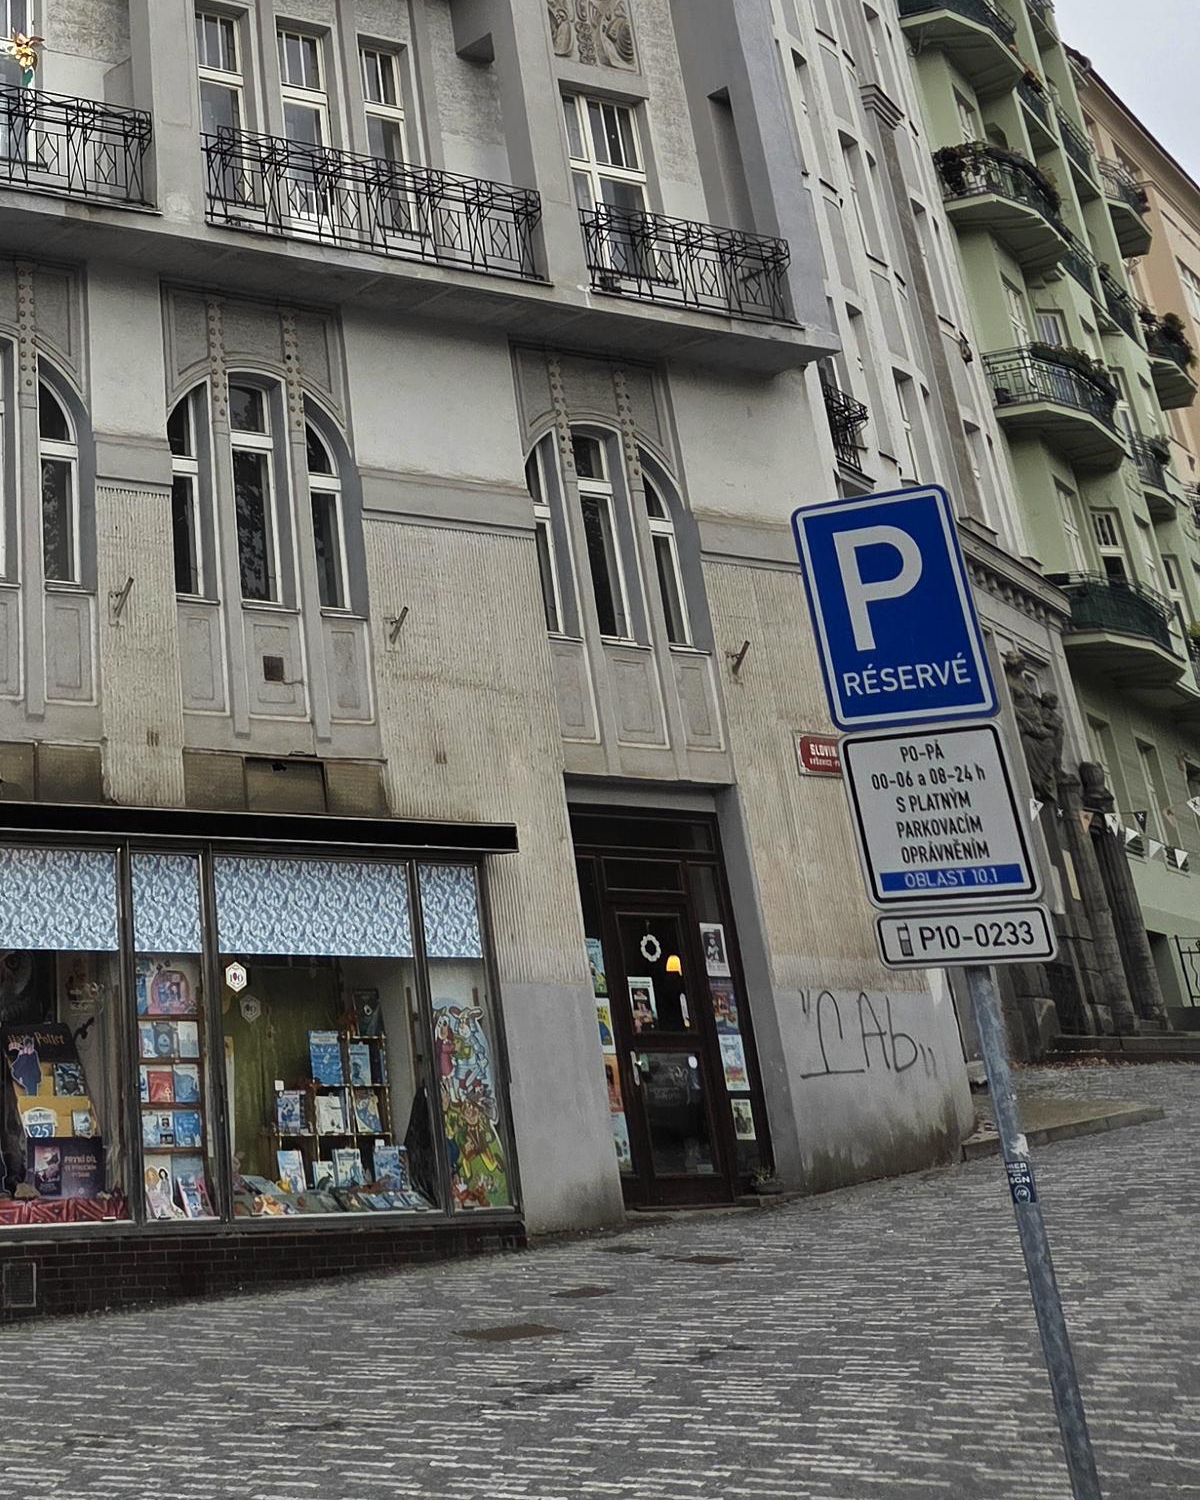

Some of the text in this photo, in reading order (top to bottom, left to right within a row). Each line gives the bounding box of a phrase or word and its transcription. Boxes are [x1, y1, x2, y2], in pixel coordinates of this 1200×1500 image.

[832, 524, 923, 652] P
[842, 653, 971, 697] RÉSERVÉ
[900, 739, 945, 763] PO-PÁ
[871, 763, 986, 790] 00-06 a 08-24 h
[896, 788, 972, 813] S PLATNÝM
[896, 813, 983, 838] PARKOVACÍM
[901, 837, 990, 864] OPRÁVNĚNÍM
[904, 867, 998, 888] OBLAST 10.1
[919, 921, 1035, 951] P10-0233
[31, 1124, 49, 1138] 25
